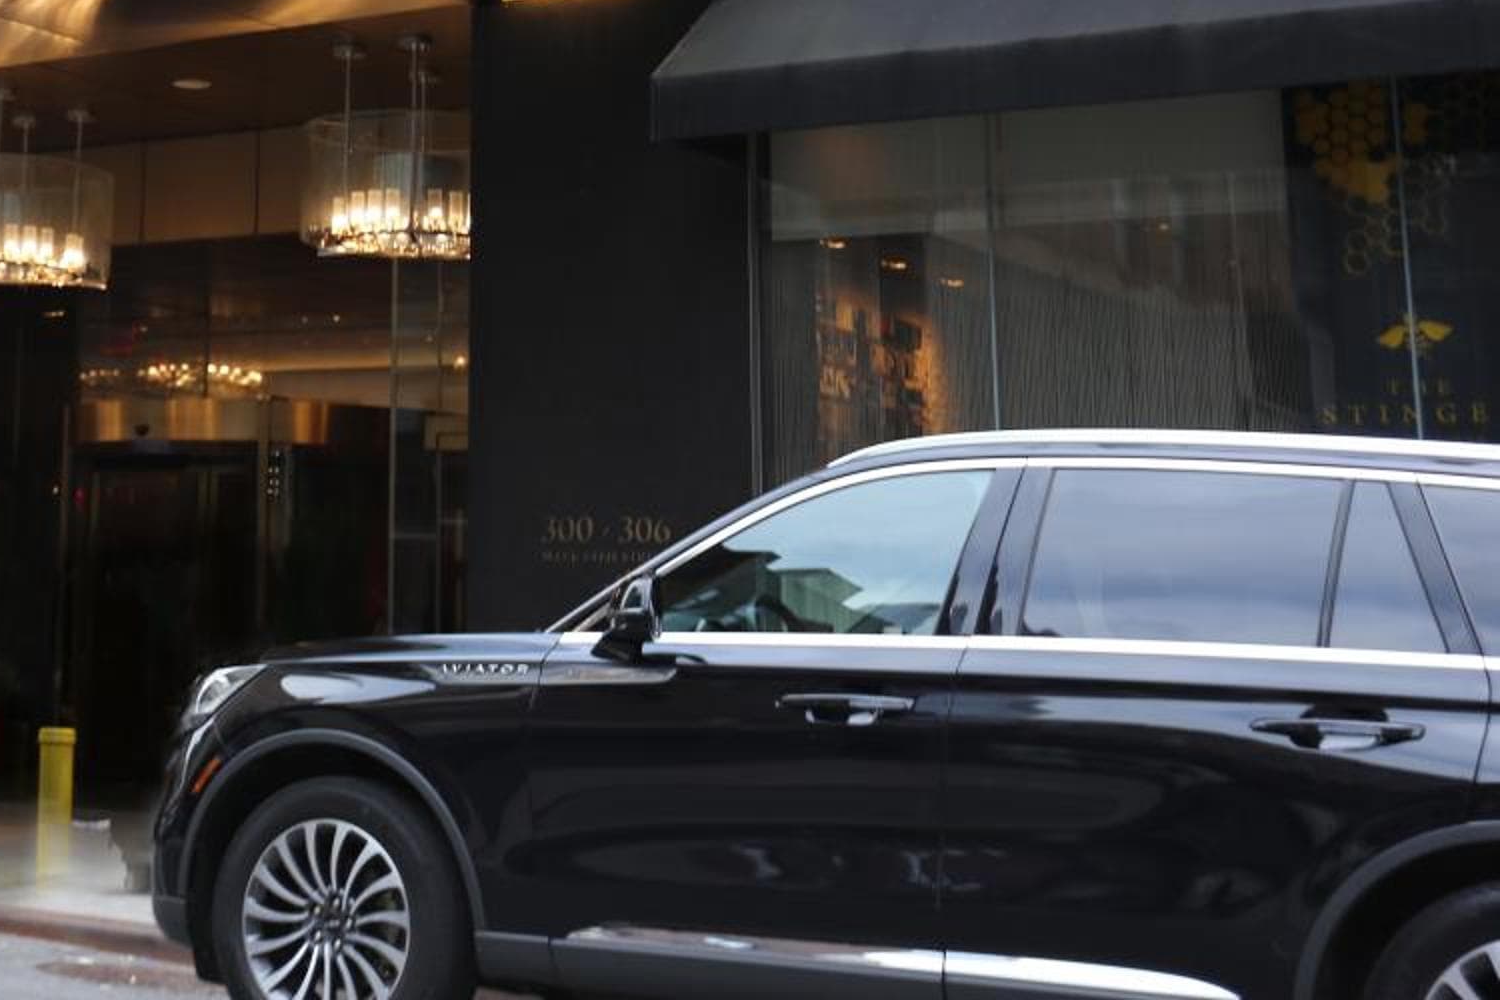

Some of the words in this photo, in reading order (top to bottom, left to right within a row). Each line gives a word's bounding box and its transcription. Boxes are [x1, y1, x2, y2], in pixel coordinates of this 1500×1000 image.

[540, 515, 595, 545] 300
[616, 515, 672, 545] 306
[438, 662, 530, 676] AVIATOR
